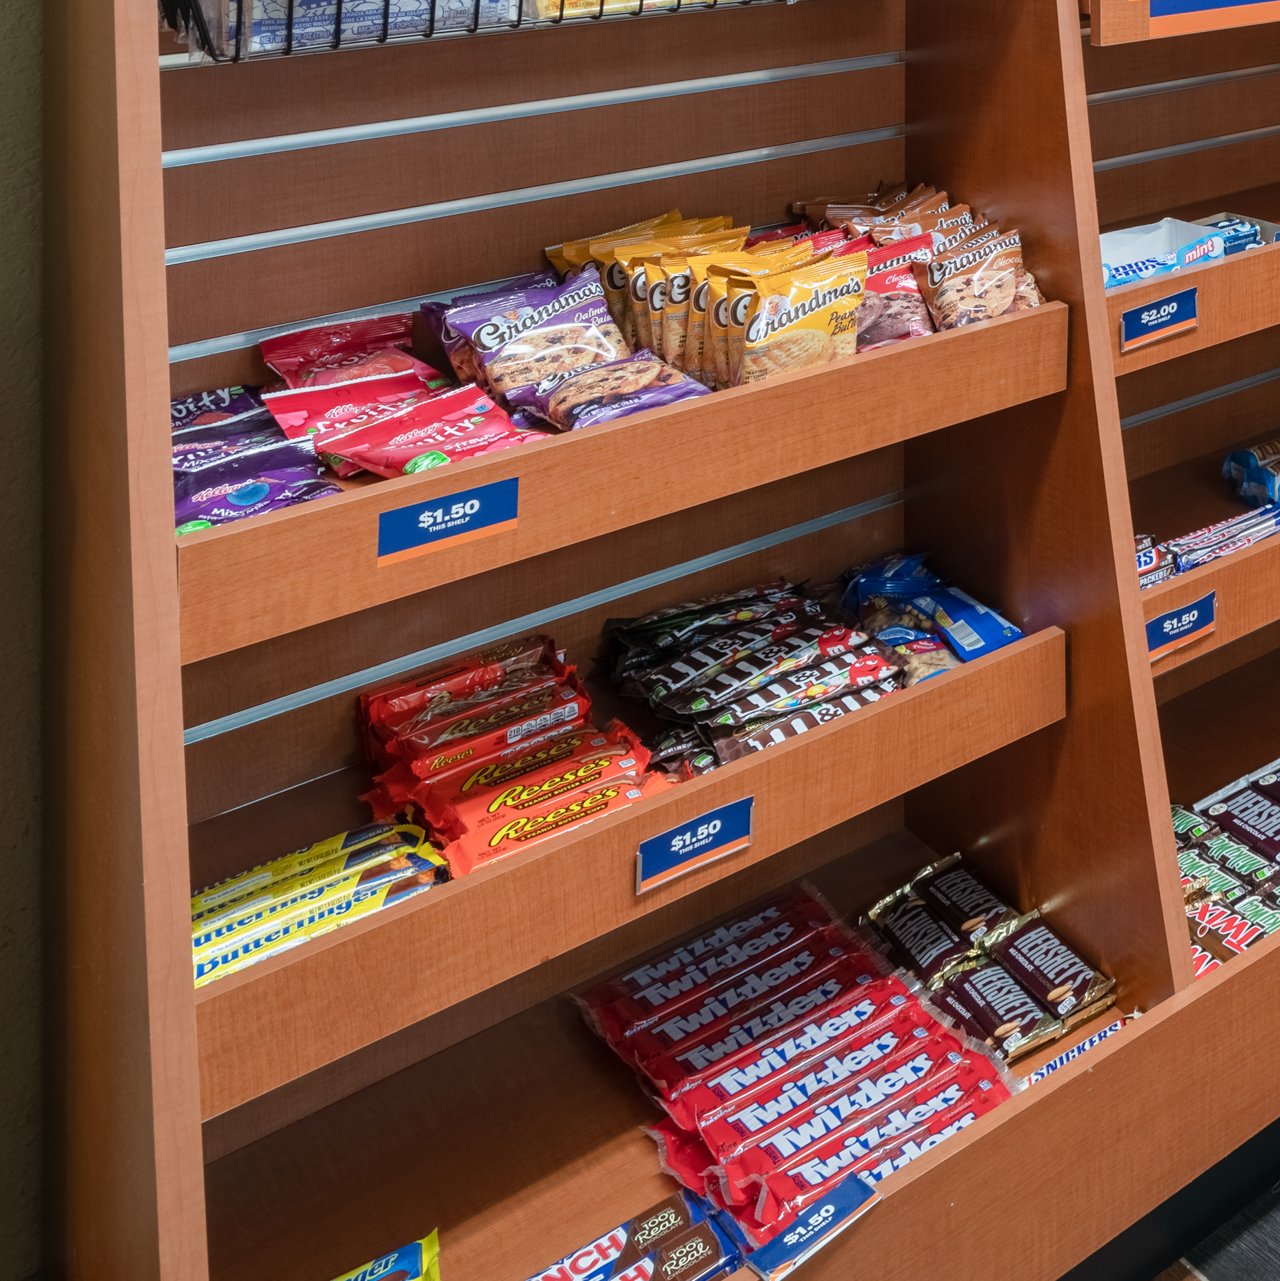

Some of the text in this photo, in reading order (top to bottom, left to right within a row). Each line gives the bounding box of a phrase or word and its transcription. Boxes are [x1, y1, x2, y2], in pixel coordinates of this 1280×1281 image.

[1185, 239, 1215, 265] mint
[744, 278, 862, 344] Grandma's
[1141, 302, 1178, 324] $2.00
[418, 499, 480, 528] $1.50
[428, 516, 471, 533] THIS SHELF
[1163, 609, 1199, 633] $1.50
[487, 757, 612, 813] Reese's
[524, 793, 553, 808] PEANUT
[581, 774, 600, 784] CUPS
[488, 786, 620, 847] Reese's
[526, 823, 557, 838] PEANUT
[587, 804, 606, 814] CUPS
[1242, 823, 1266, 841] CHOCOLATE
[670, 819, 722, 852] $1.50
[679, 836, 714, 855] THIS SHELF
[622, 906, 782, 989] Twizzlers
[633, 922, 795, 1007] Twizzlers
[1014, 925, 1096, 990] HERSHEY'S
[651, 950, 815, 1042] Twizzlers
[969, 966, 1045, 1027] HERSHEY'S
[675, 976, 843, 1070] Twizzlers
[706, 997, 877, 1098] Twizzlers
[1030, 1021, 1123, 1083] SNICKERS
[727, 1030, 900, 1134] Twizzlers
[758, 1052, 935, 1160] Twizzlers
[786, 1083, 965, 1187] Twizzlers
[634, 1214, 682, 1245] Real
[638, 1220, 686, 1250] CHOCOLATE
[641, 1208, 675, 1229] 100%
[782, 1203, 837, 1247] $1.50
[799, 1215, 834, 1243] THIS SHELF
[661, 1243, 711, 1276] Real
[666, 1250, 713, 1281] CHOCOLATE
[668, 1236, 703, 1261] 100%
